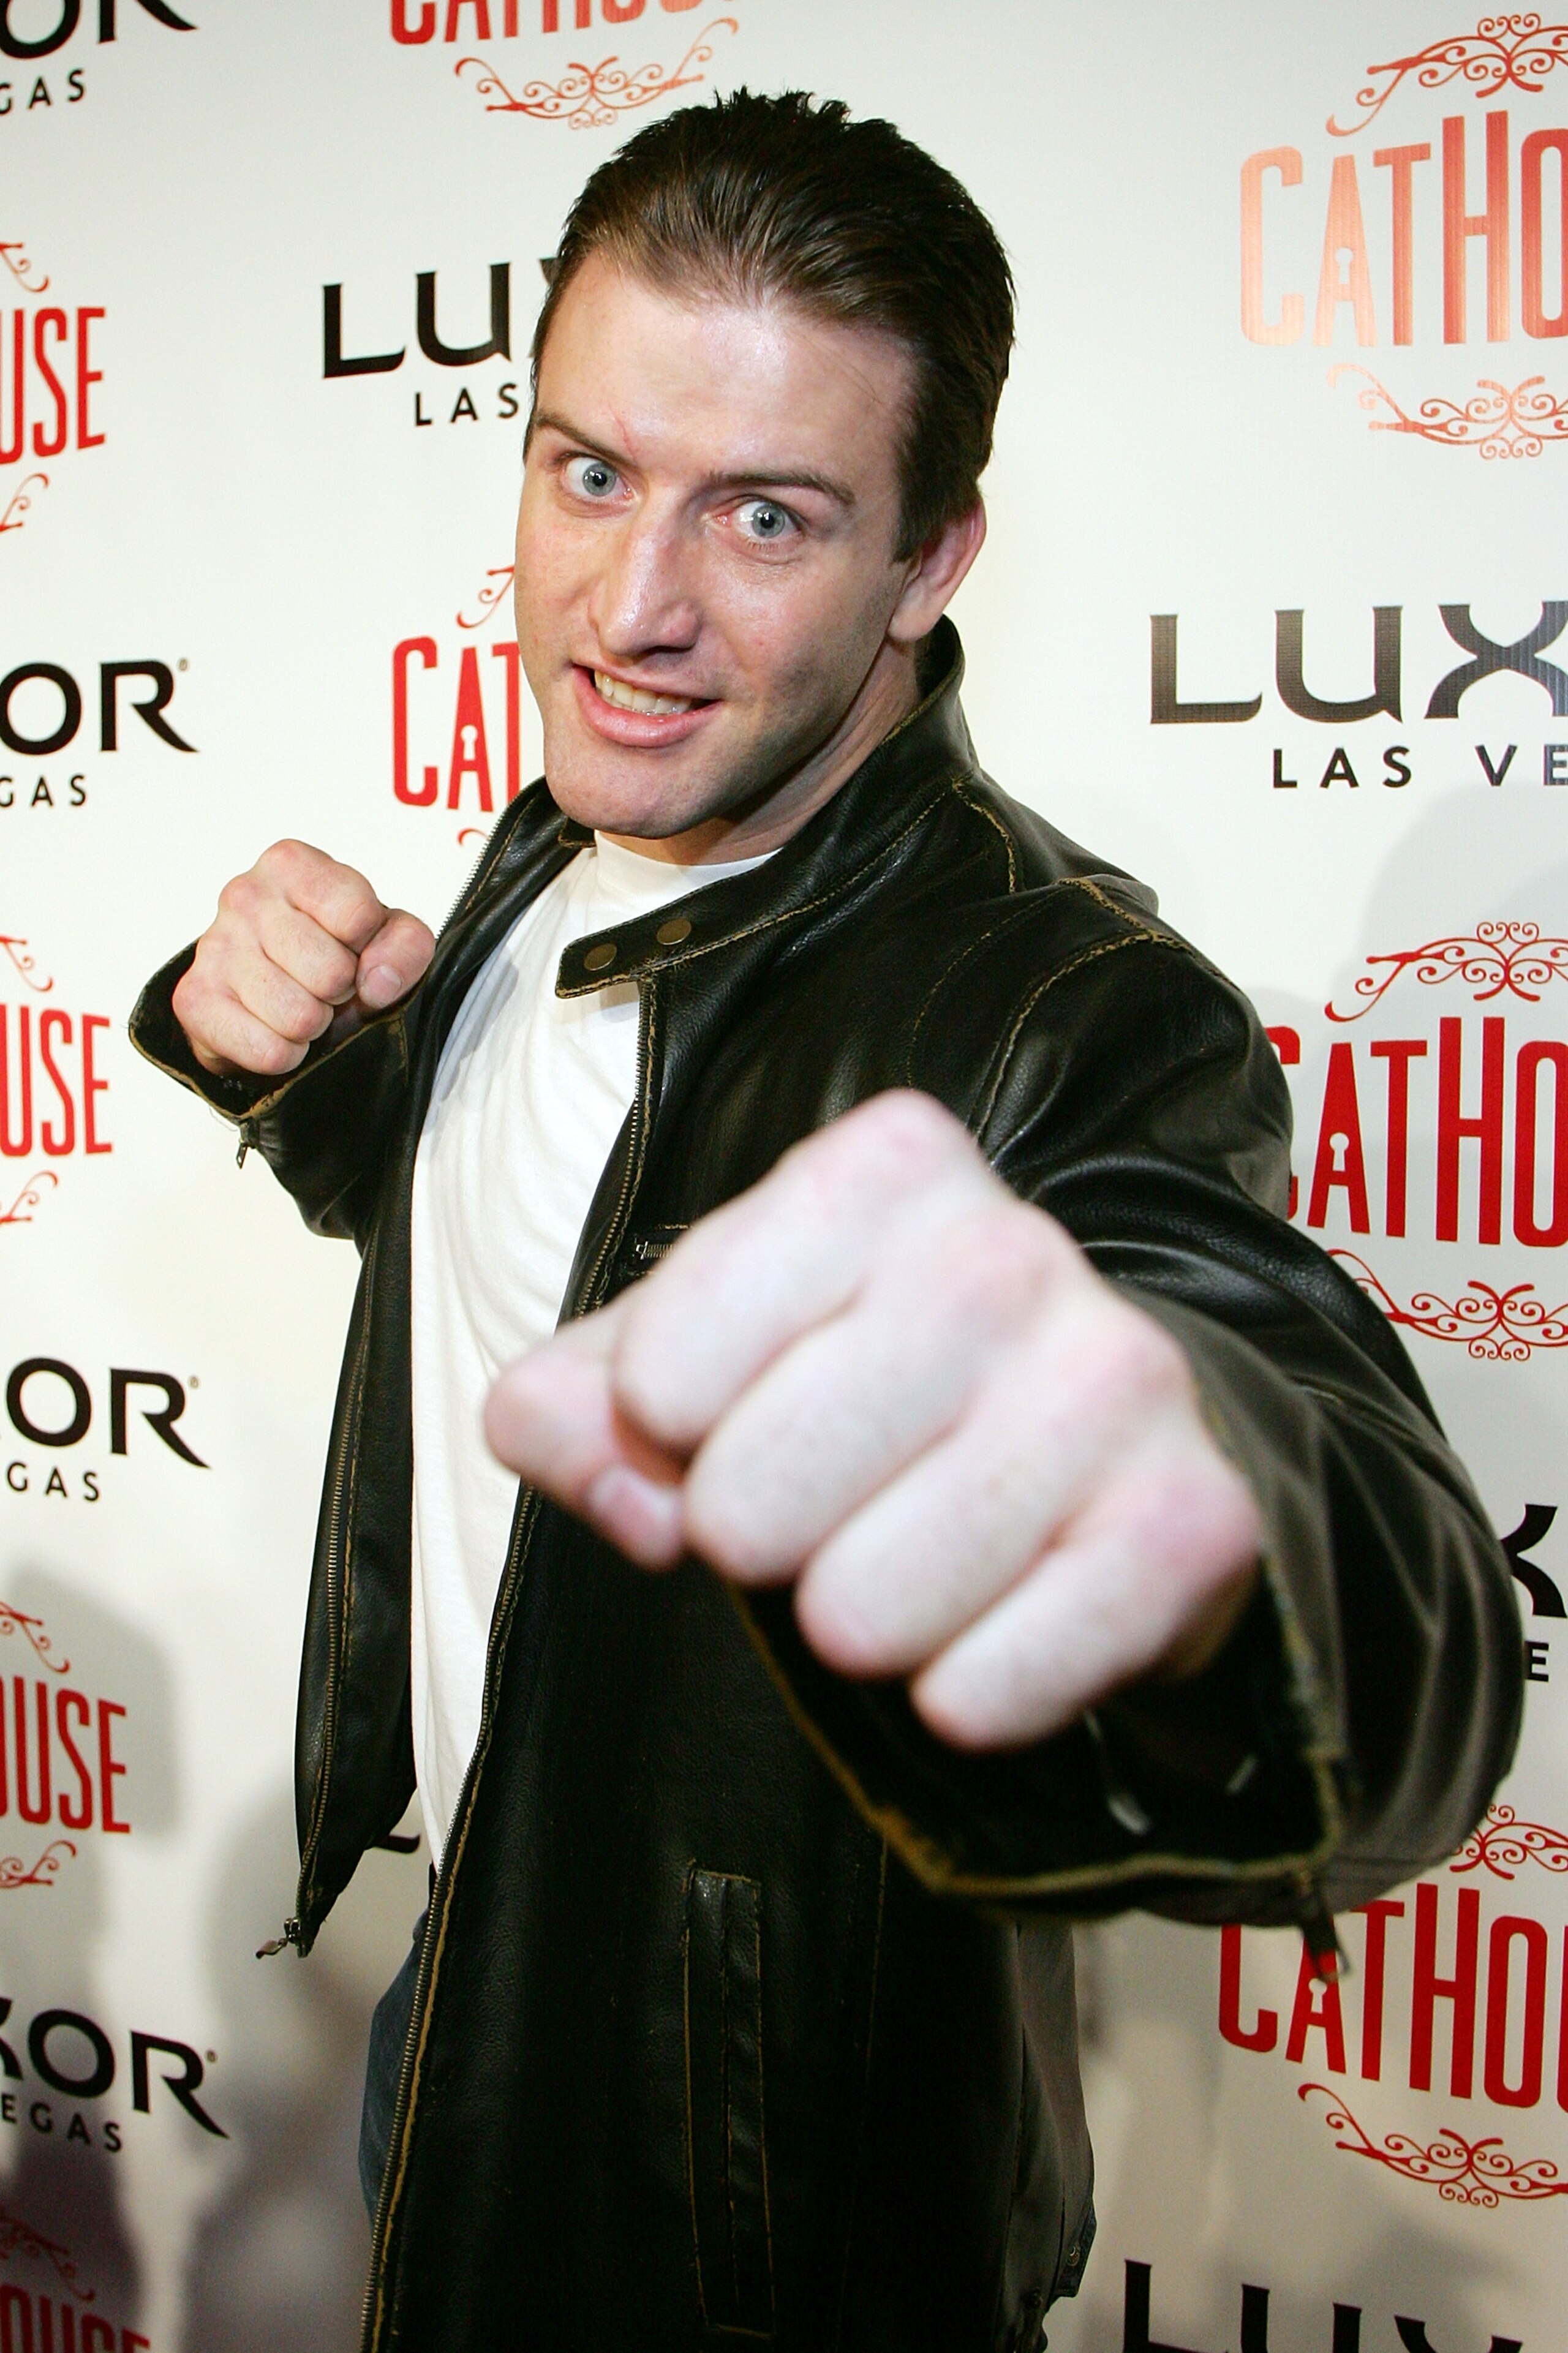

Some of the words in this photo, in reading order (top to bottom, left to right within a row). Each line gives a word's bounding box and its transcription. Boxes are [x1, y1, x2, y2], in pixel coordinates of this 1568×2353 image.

[0, 69, 85, 116] GAS
[322, 256, 559, 379] LU
[415, 382, 519, 427] LAS
[0, 660, 198, 756] OR
[1150, 600, 1568, 725] LUX
[393, 635, 520, 813] CAT
[1273, 745, 1412, 789] LAS
[1475, 744, 1568, 787] VE
[0, 774, 86, 808] GAS
[1266, 1017, 1568, 1248] ATHO
[6, 1357, 212, 1469] OR
[7, 1461, 100, 1502] GAS
[0, 1676, 130, 1834] USE
[1218, 1883, 1568, 2114] CATHO
[0, 1997, 230, 2140] OR
[1, 2093, 123, 2153] EGAS
